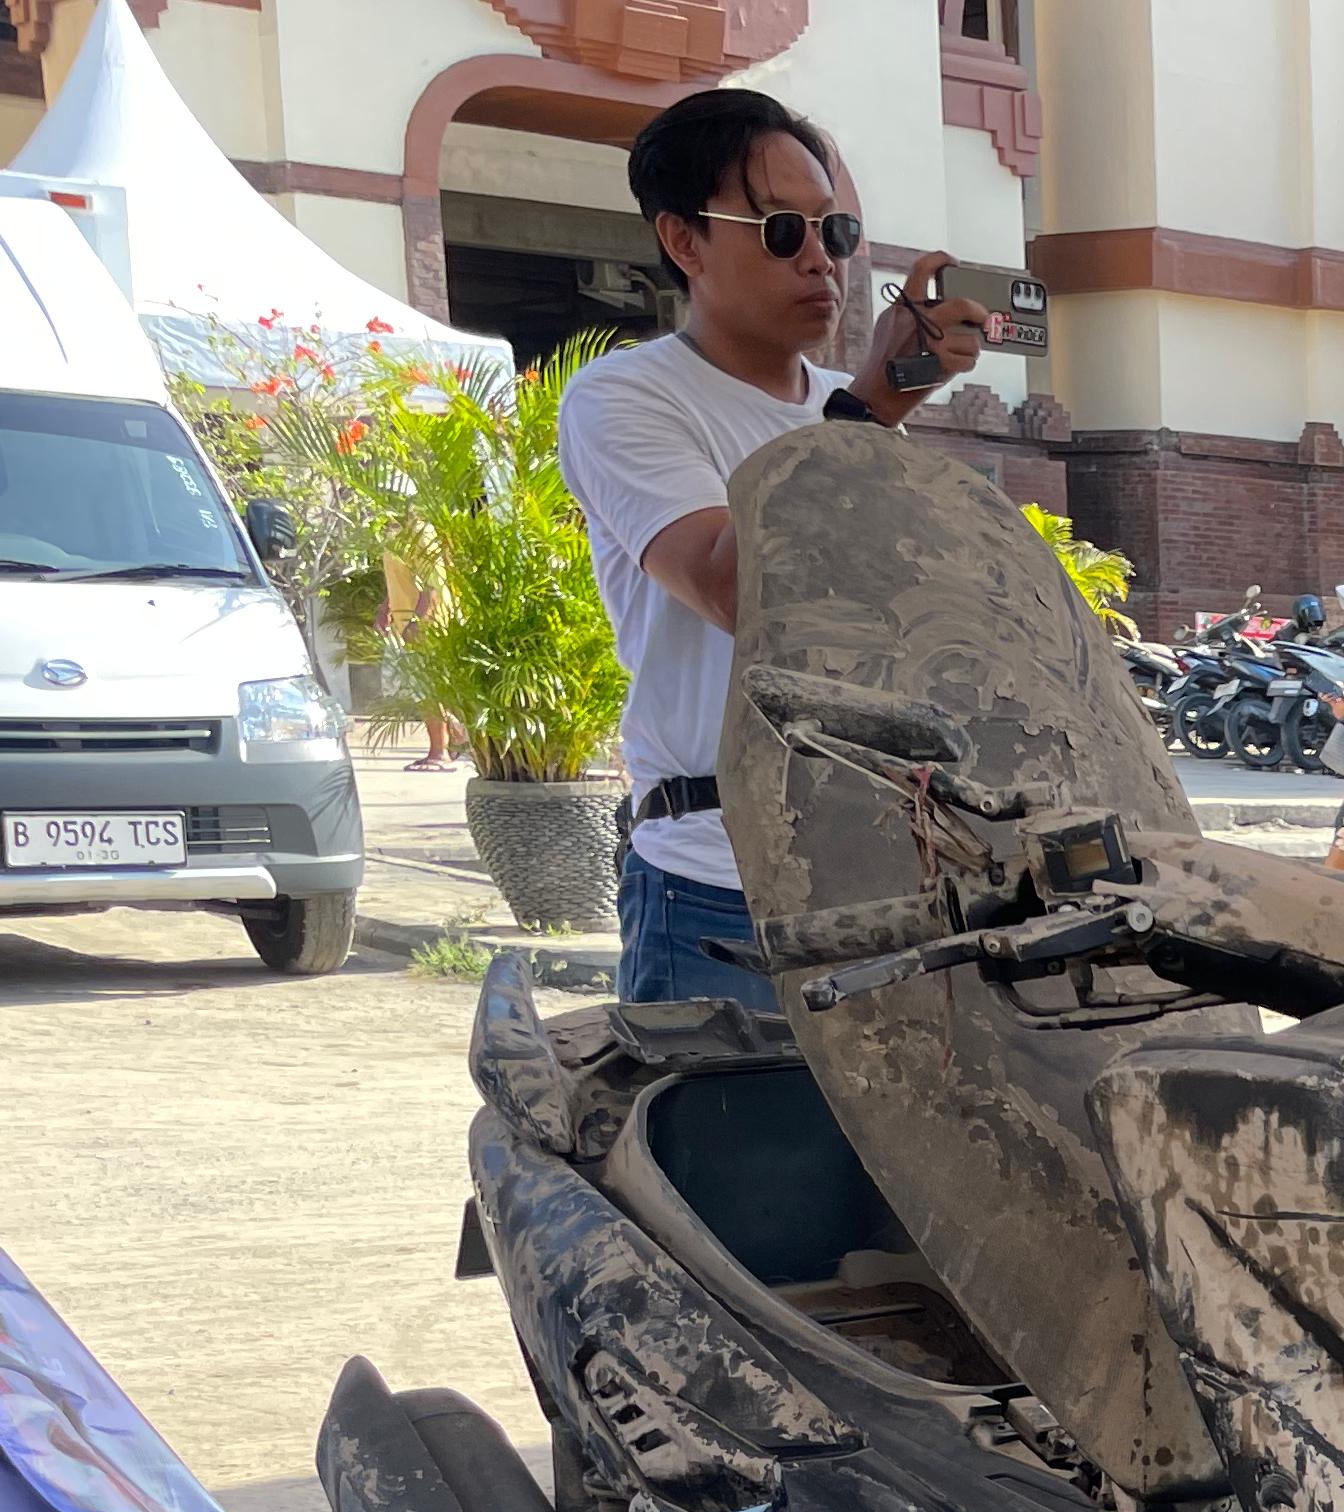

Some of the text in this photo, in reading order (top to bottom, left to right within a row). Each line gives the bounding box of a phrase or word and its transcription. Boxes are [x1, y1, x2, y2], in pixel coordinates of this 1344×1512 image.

[13, 820, 179, 849] B 9594 TCS
